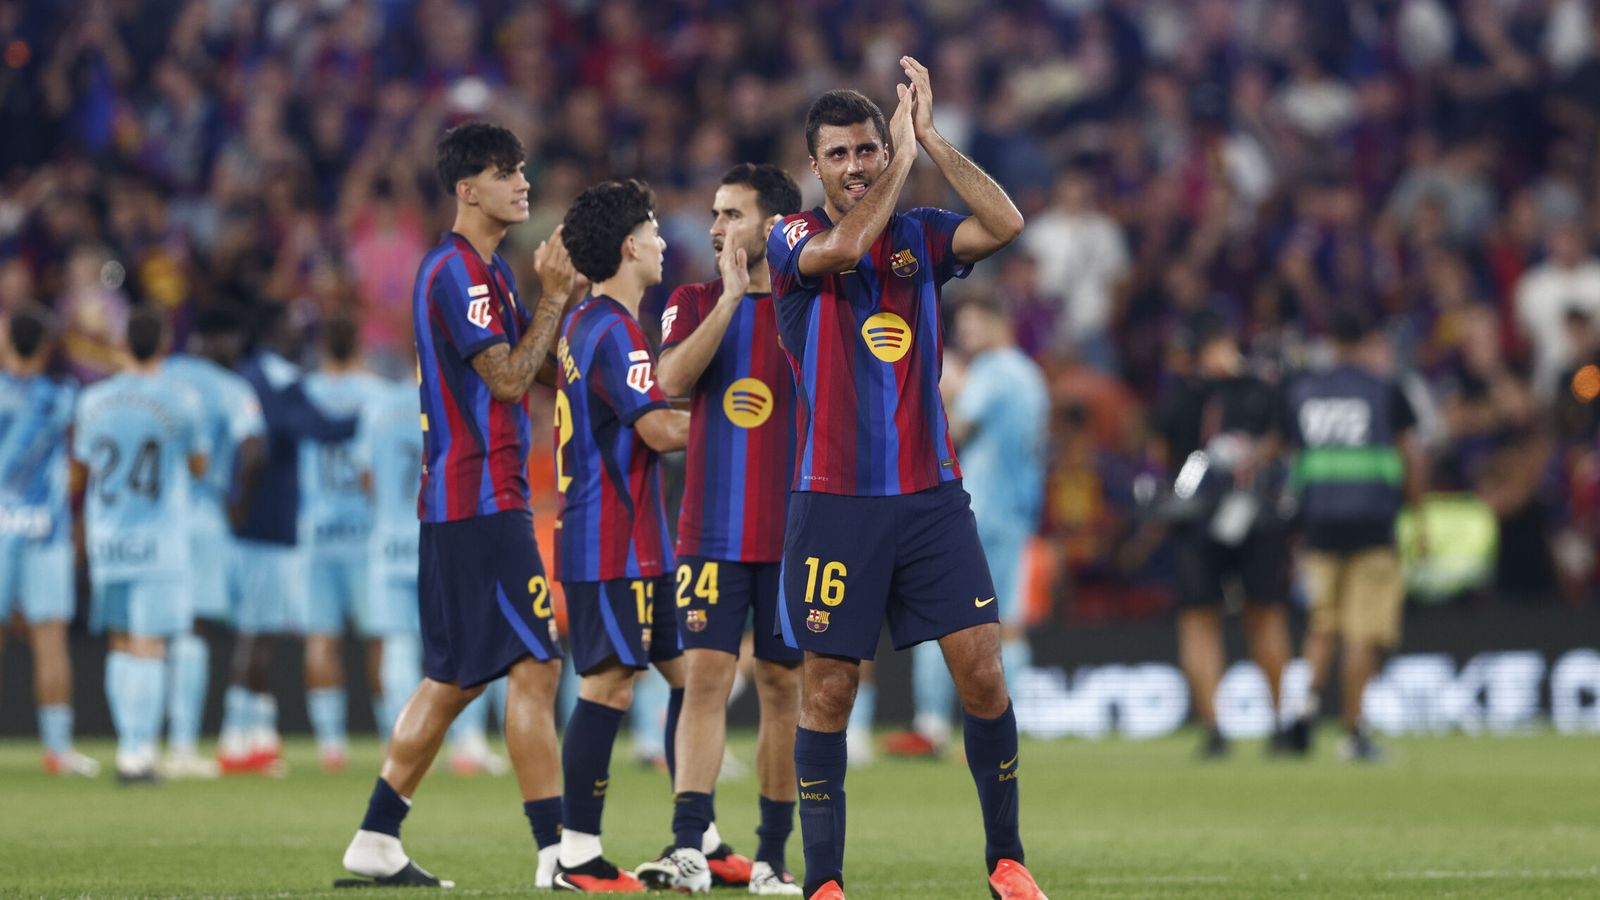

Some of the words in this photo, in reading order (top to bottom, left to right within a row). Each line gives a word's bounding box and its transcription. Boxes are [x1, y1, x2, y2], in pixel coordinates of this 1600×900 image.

[91, 435, 161, 507] 24
[527, 575, 554, 619] 2
[676, 561, 719, 608] 24
[804, 556, 847, 607] 16
[801, 791, 830, 801] BARÇA
